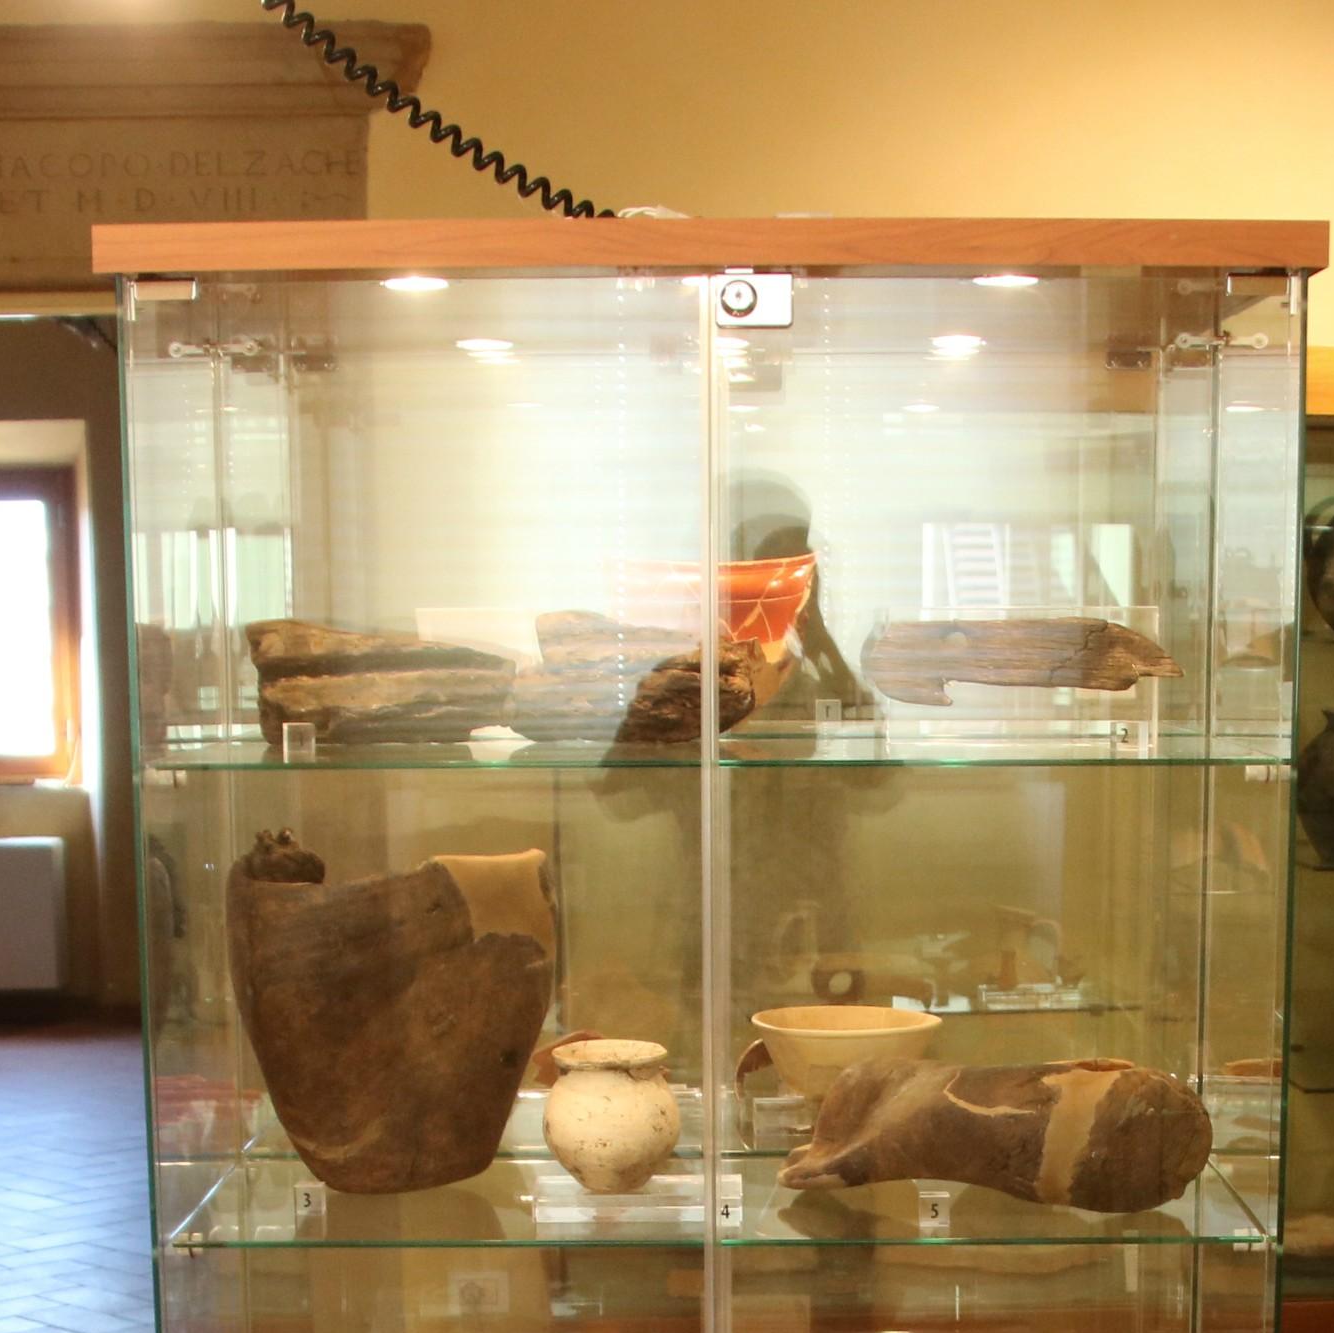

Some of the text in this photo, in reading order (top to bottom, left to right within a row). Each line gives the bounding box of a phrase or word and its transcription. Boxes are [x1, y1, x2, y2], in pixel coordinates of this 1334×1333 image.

[1121, 727, 1129, 744] 2
[303, 1192, 312, 1208] 3
[721, 1204, 730, 1219] 4
[930, 1203, 939, 1219] 5
